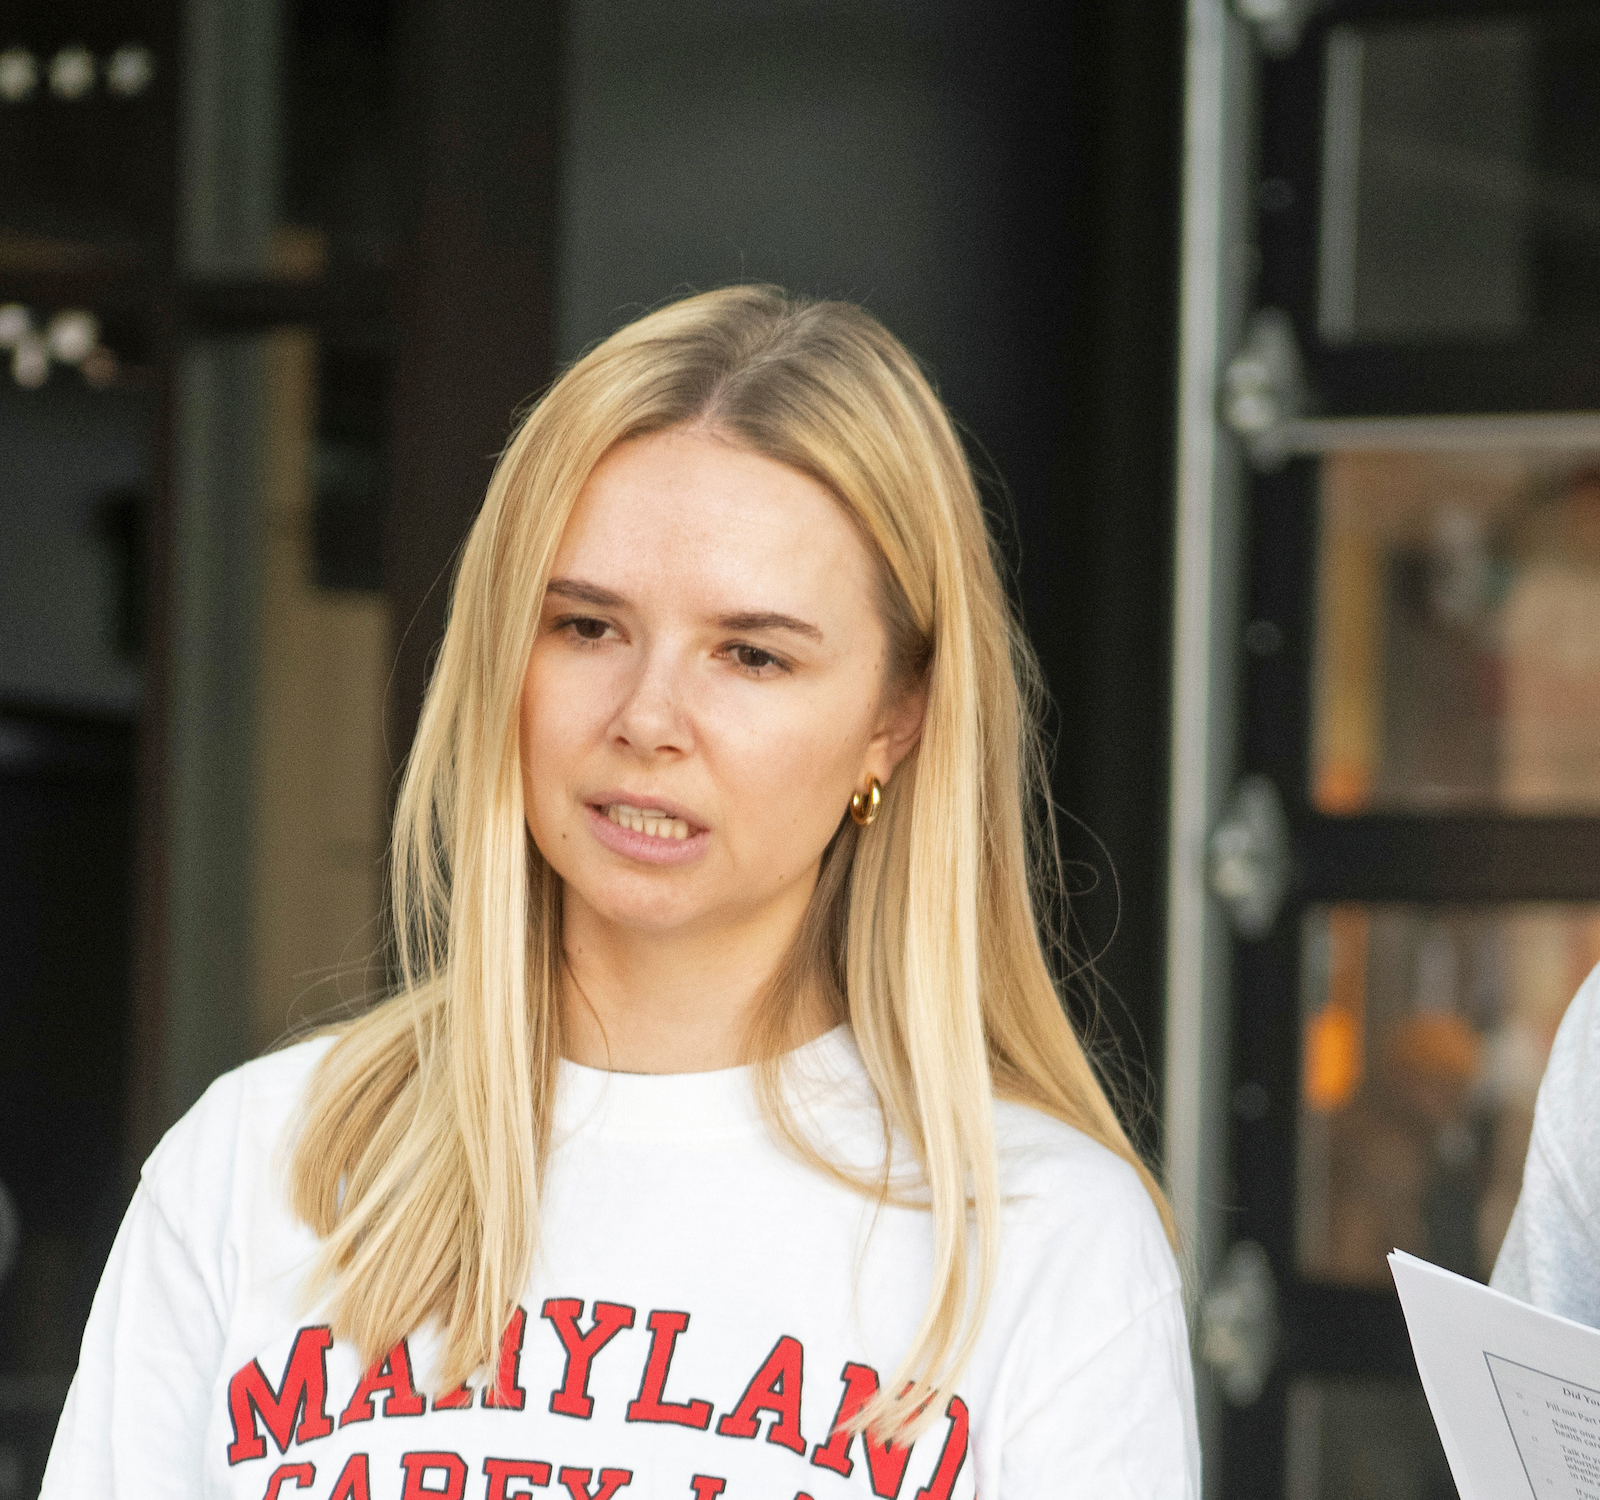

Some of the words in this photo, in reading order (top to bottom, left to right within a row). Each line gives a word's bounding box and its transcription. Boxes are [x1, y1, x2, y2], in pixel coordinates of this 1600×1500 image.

[1562, 1387, 1581, 1400] Did
[1545, 1401, 1560, 1412] Fill
[1578, 1412, 1597, 1425] Part
[1551, 1419, 1576, 1433] Name
[1554, 1428, 1582, 1442] health
[1584, 1440, 1600, 1449] care
[1562, 1446, 1579, 1456] Talk
